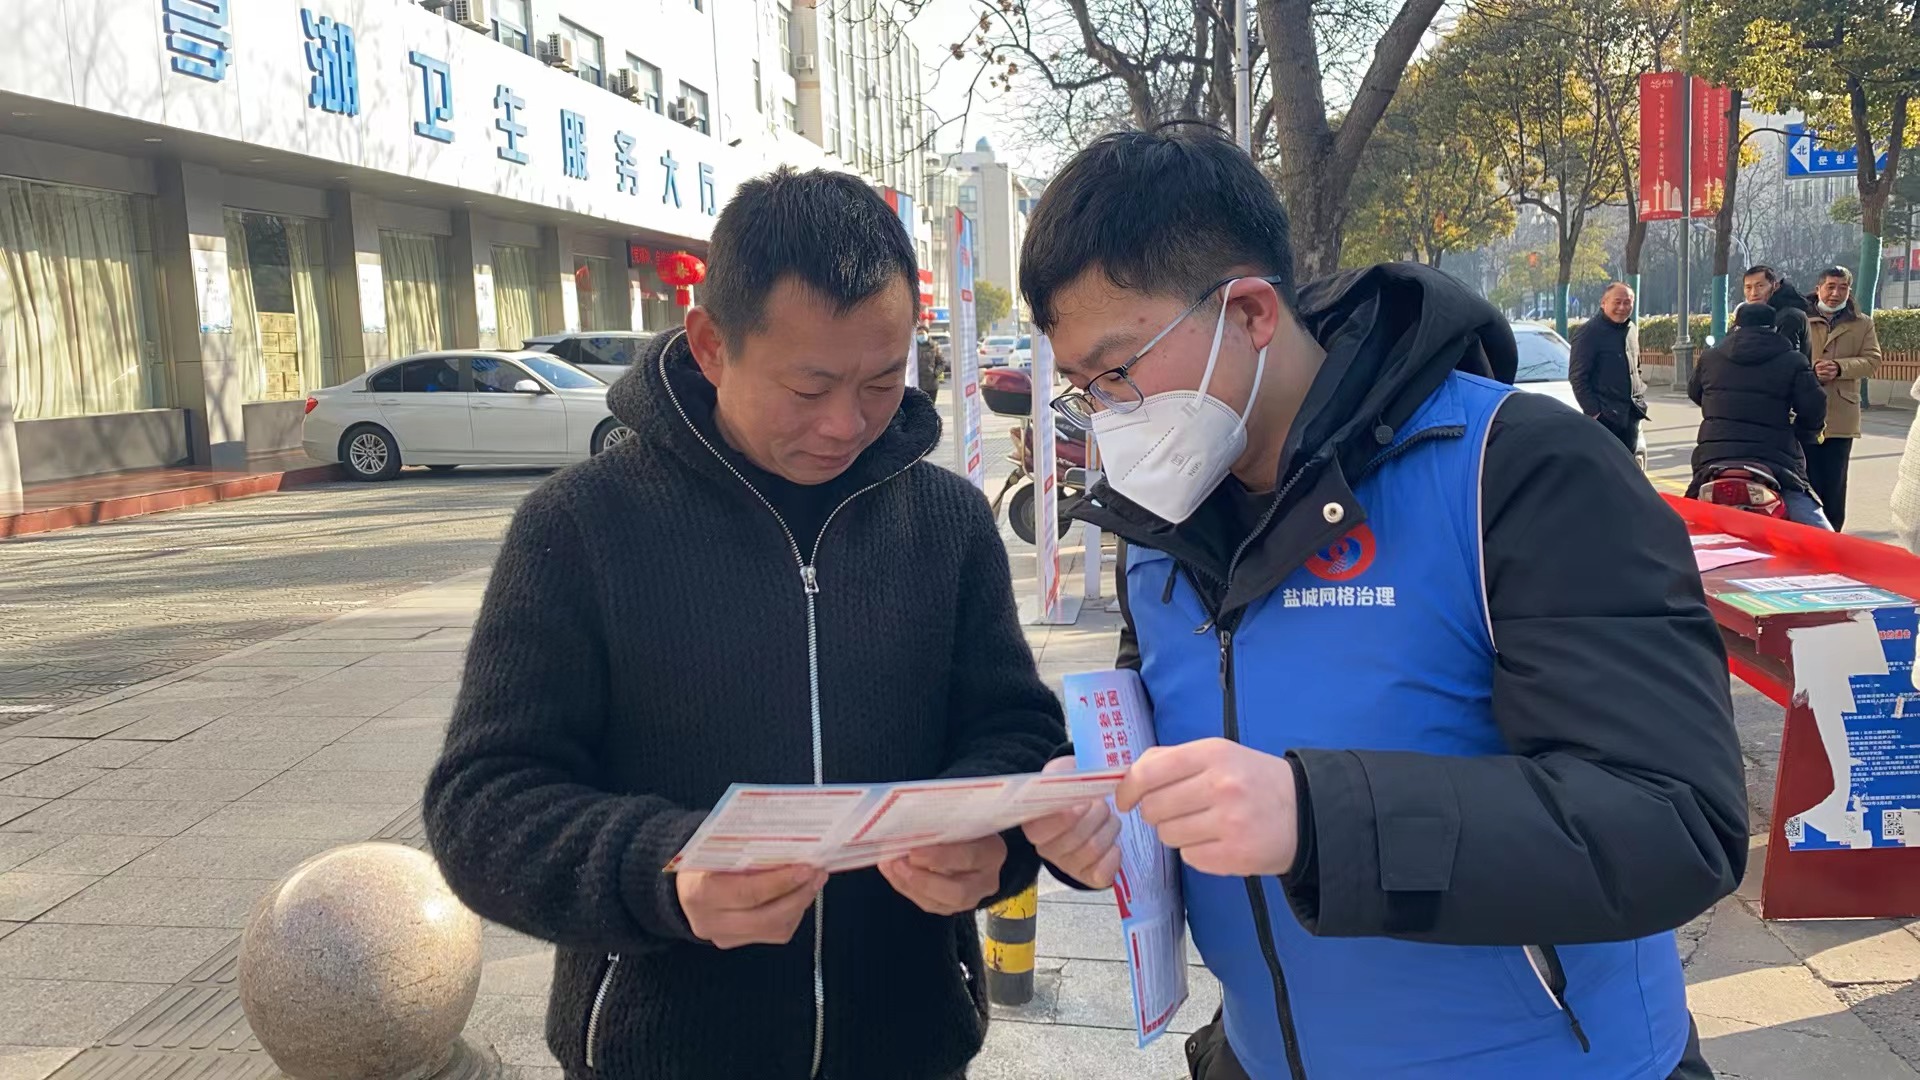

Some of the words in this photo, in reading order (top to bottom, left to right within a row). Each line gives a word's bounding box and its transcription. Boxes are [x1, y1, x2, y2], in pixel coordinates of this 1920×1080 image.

[1797, 145, 1808, 156] 北
[1283, 586, 1396, 608] 盐城网格治理
